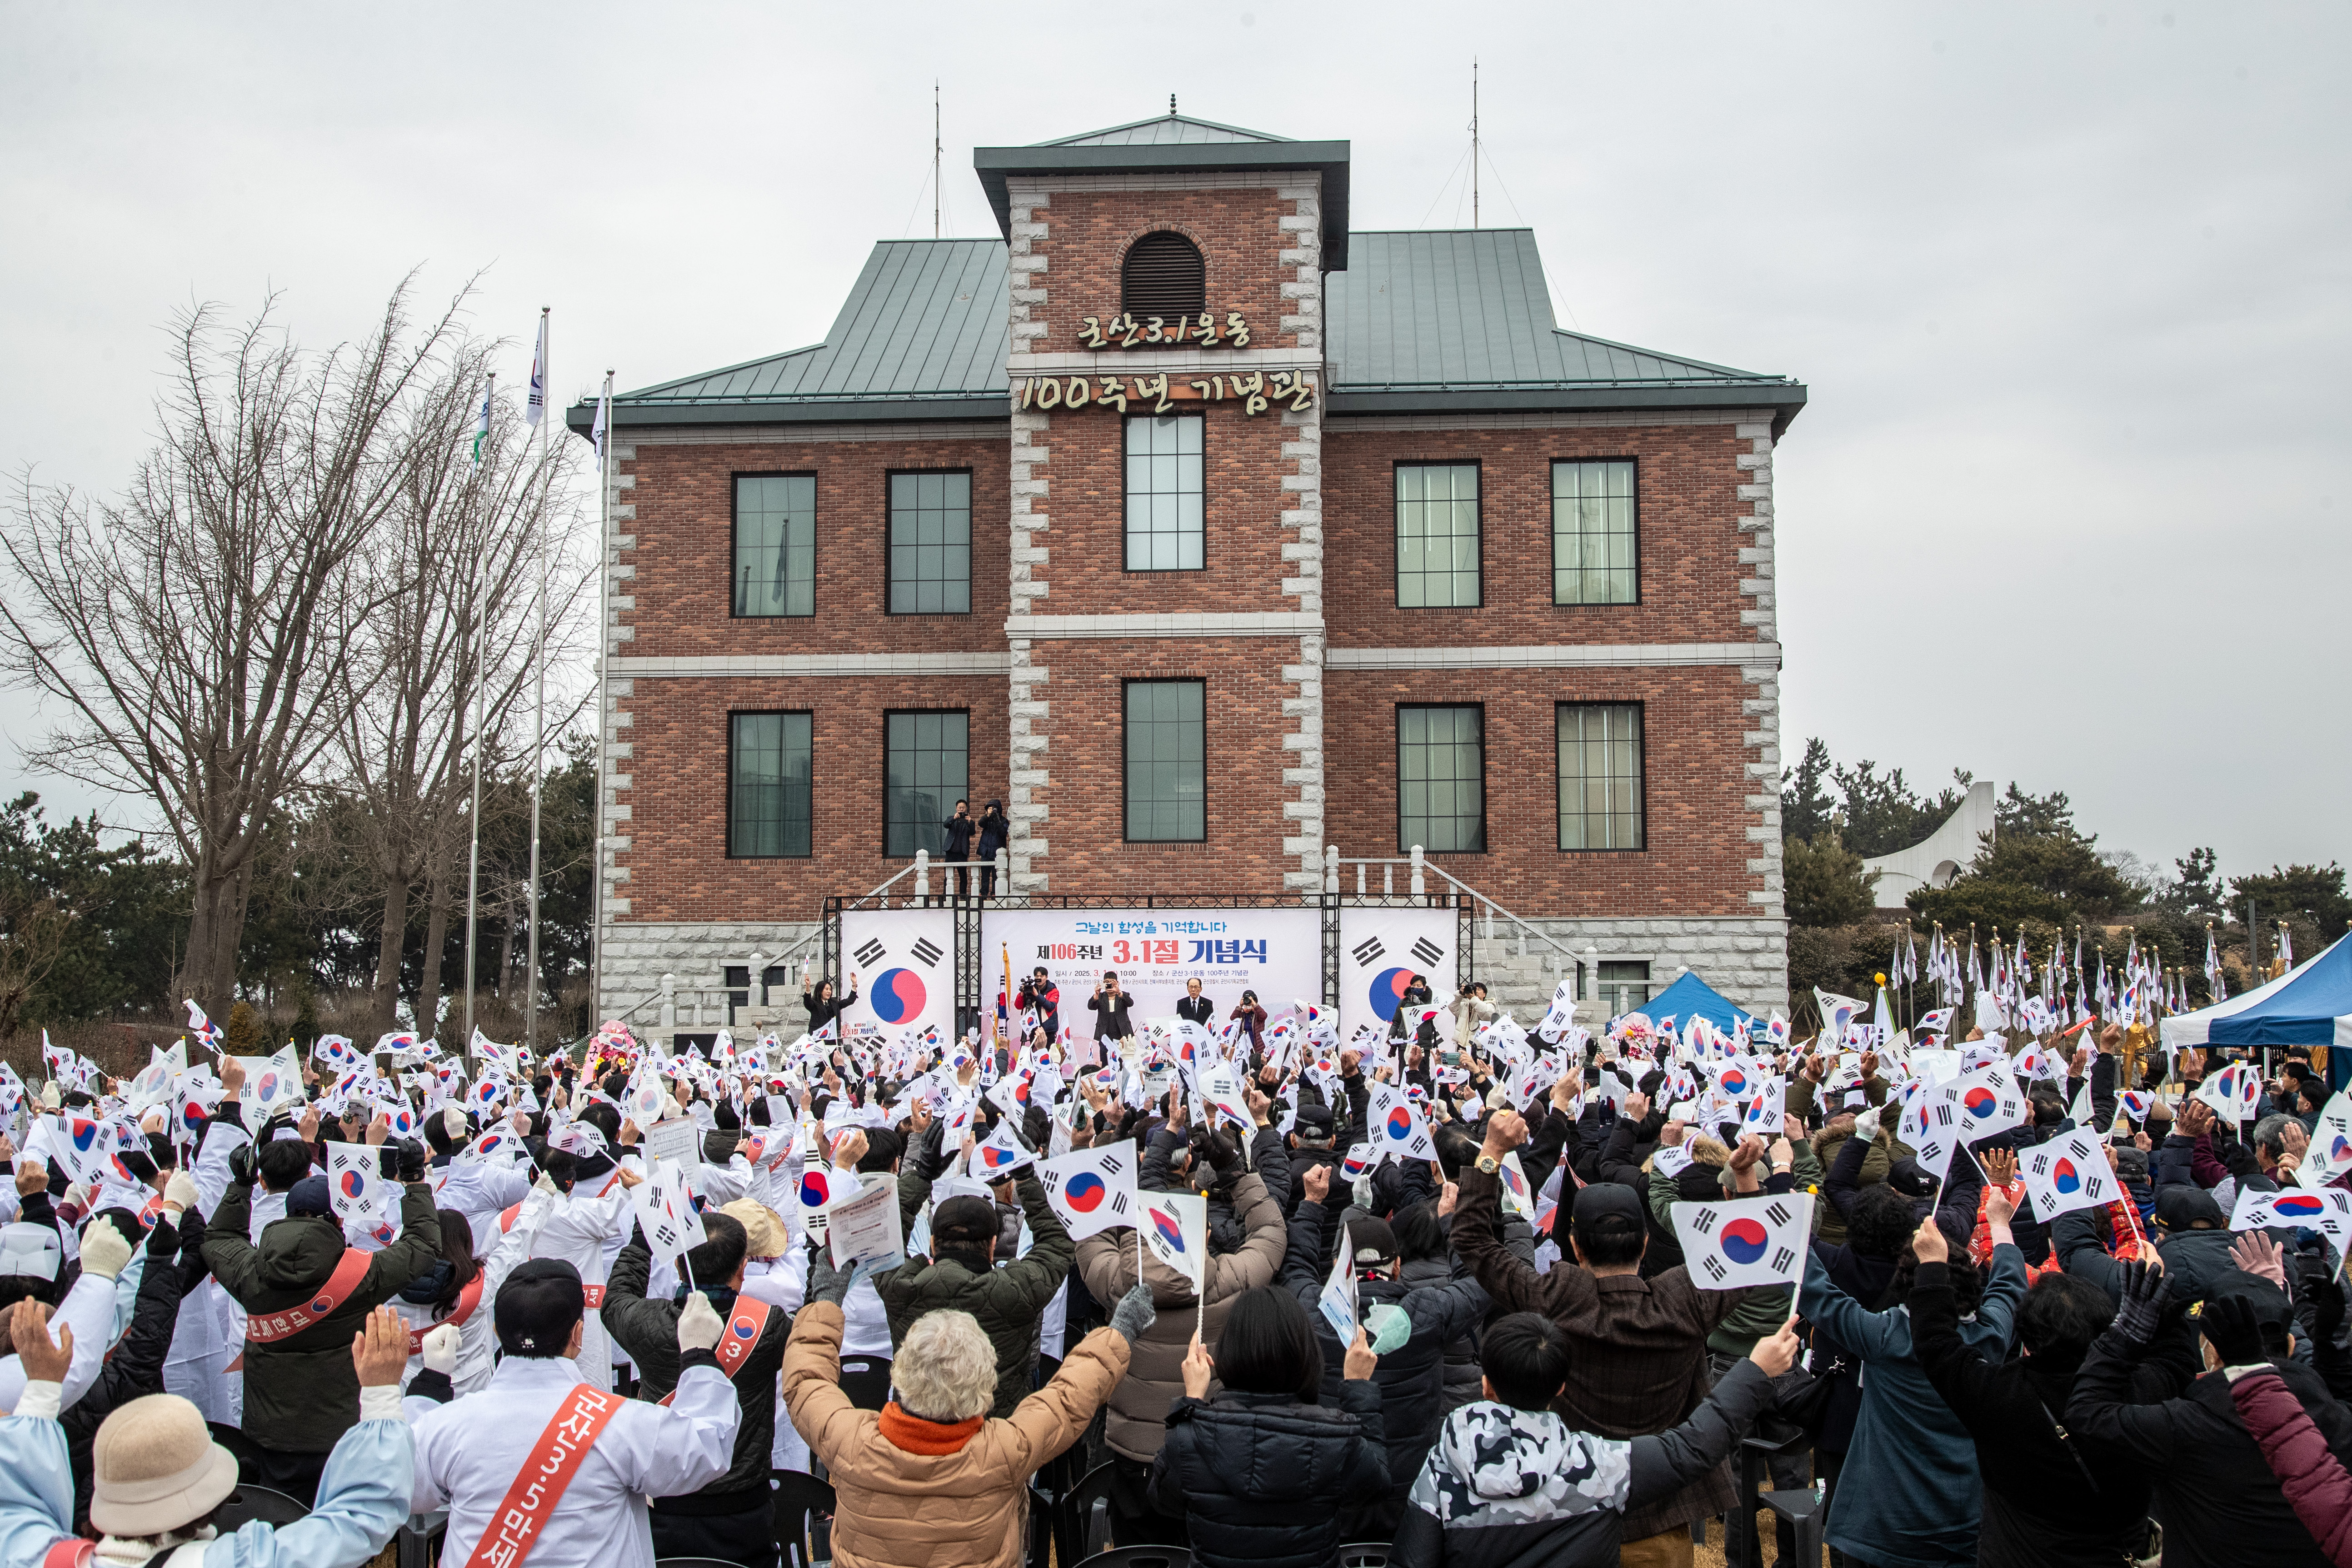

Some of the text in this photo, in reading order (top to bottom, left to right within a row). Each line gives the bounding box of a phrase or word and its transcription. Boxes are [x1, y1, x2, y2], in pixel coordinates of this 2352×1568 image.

[1021, 369, 1313, 416] 100주년 기념관
[1076, 921, 1228, 934] 그날의 함성을 기억합니다
[1037, 939, 1266, 964] 제106주년 3.1절 기념식
[481, 1390, 608, 1568] 군산3·5만세
